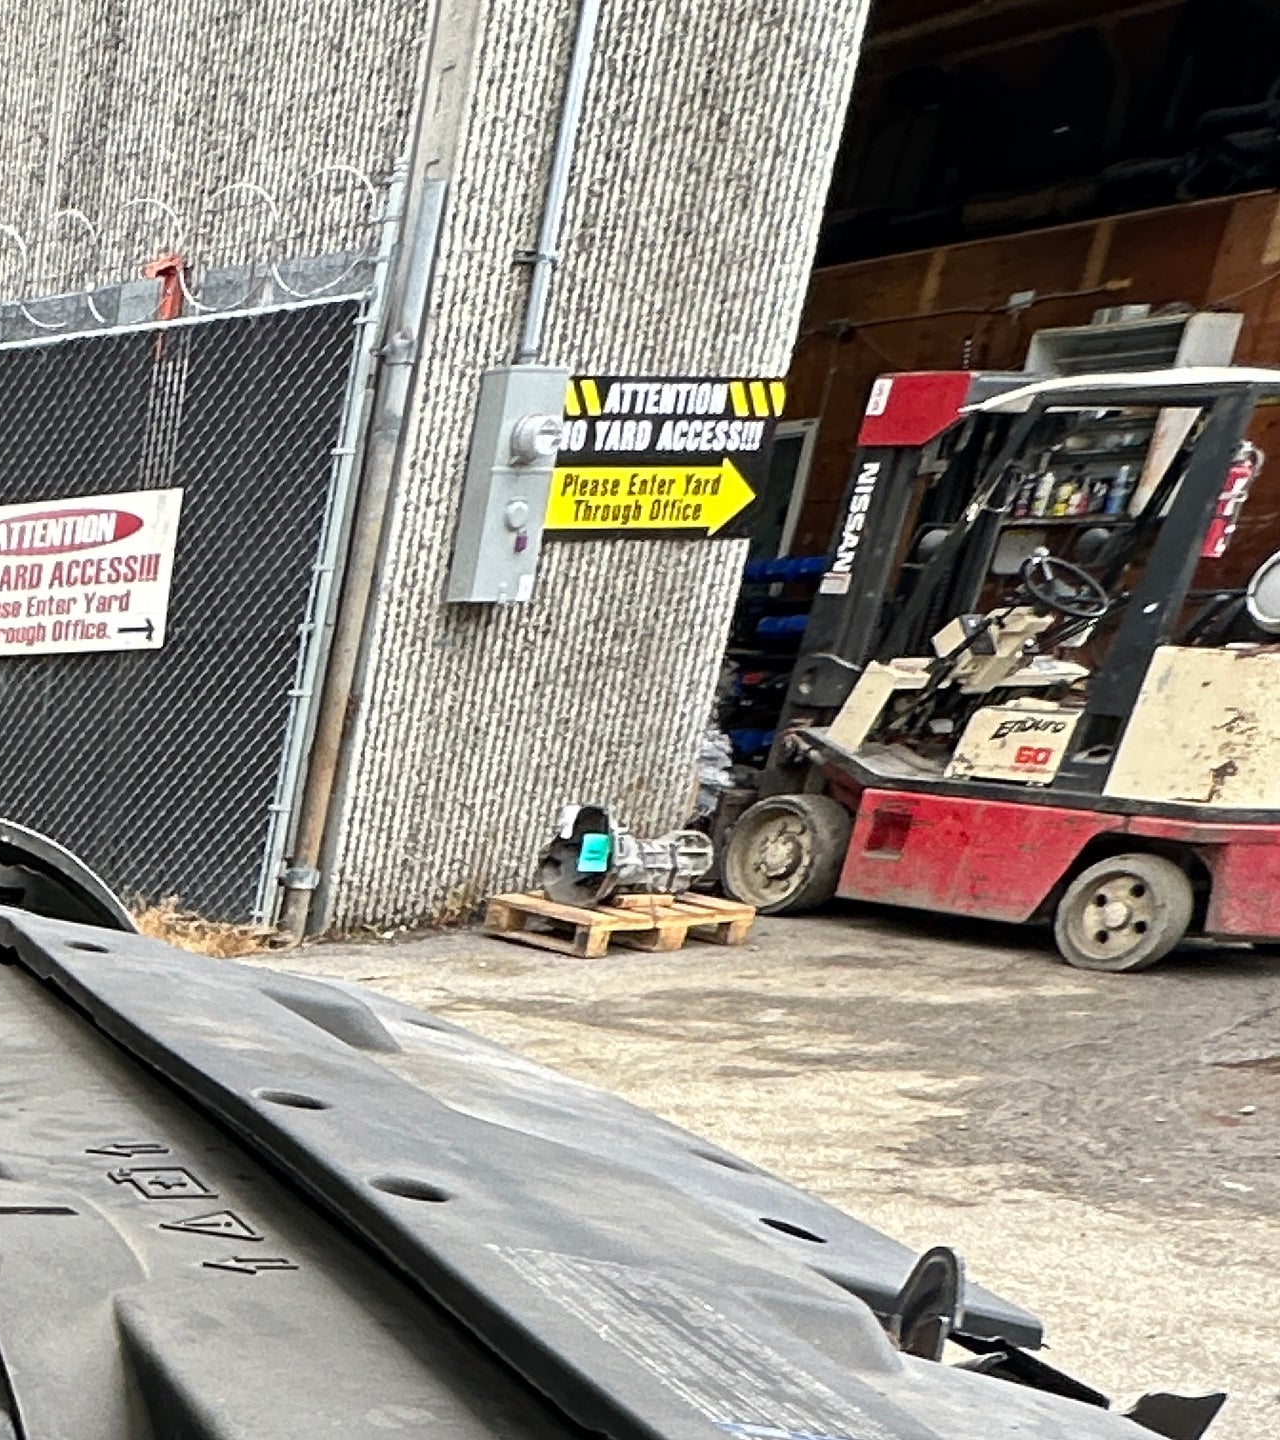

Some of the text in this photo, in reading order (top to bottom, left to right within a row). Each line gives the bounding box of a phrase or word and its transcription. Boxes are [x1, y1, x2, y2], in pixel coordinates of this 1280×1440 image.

[603, 382, 728, 415] ATTENTION
[594, 421, 653, 451] YARD
[656, 421, 765, 451] ACCESS!!!
[561, 473, 722, 496] Please Enter Yard
[573, 500, 702, 524] Through Office
[833, 461, 881, 572] NISSAN
[49, 553, 161, 588] ACCESS!!!
[26, 595, 77, 617] Enter
[84, 590, 131, 614] Yard
[52, 620, 111, 641] Office.
